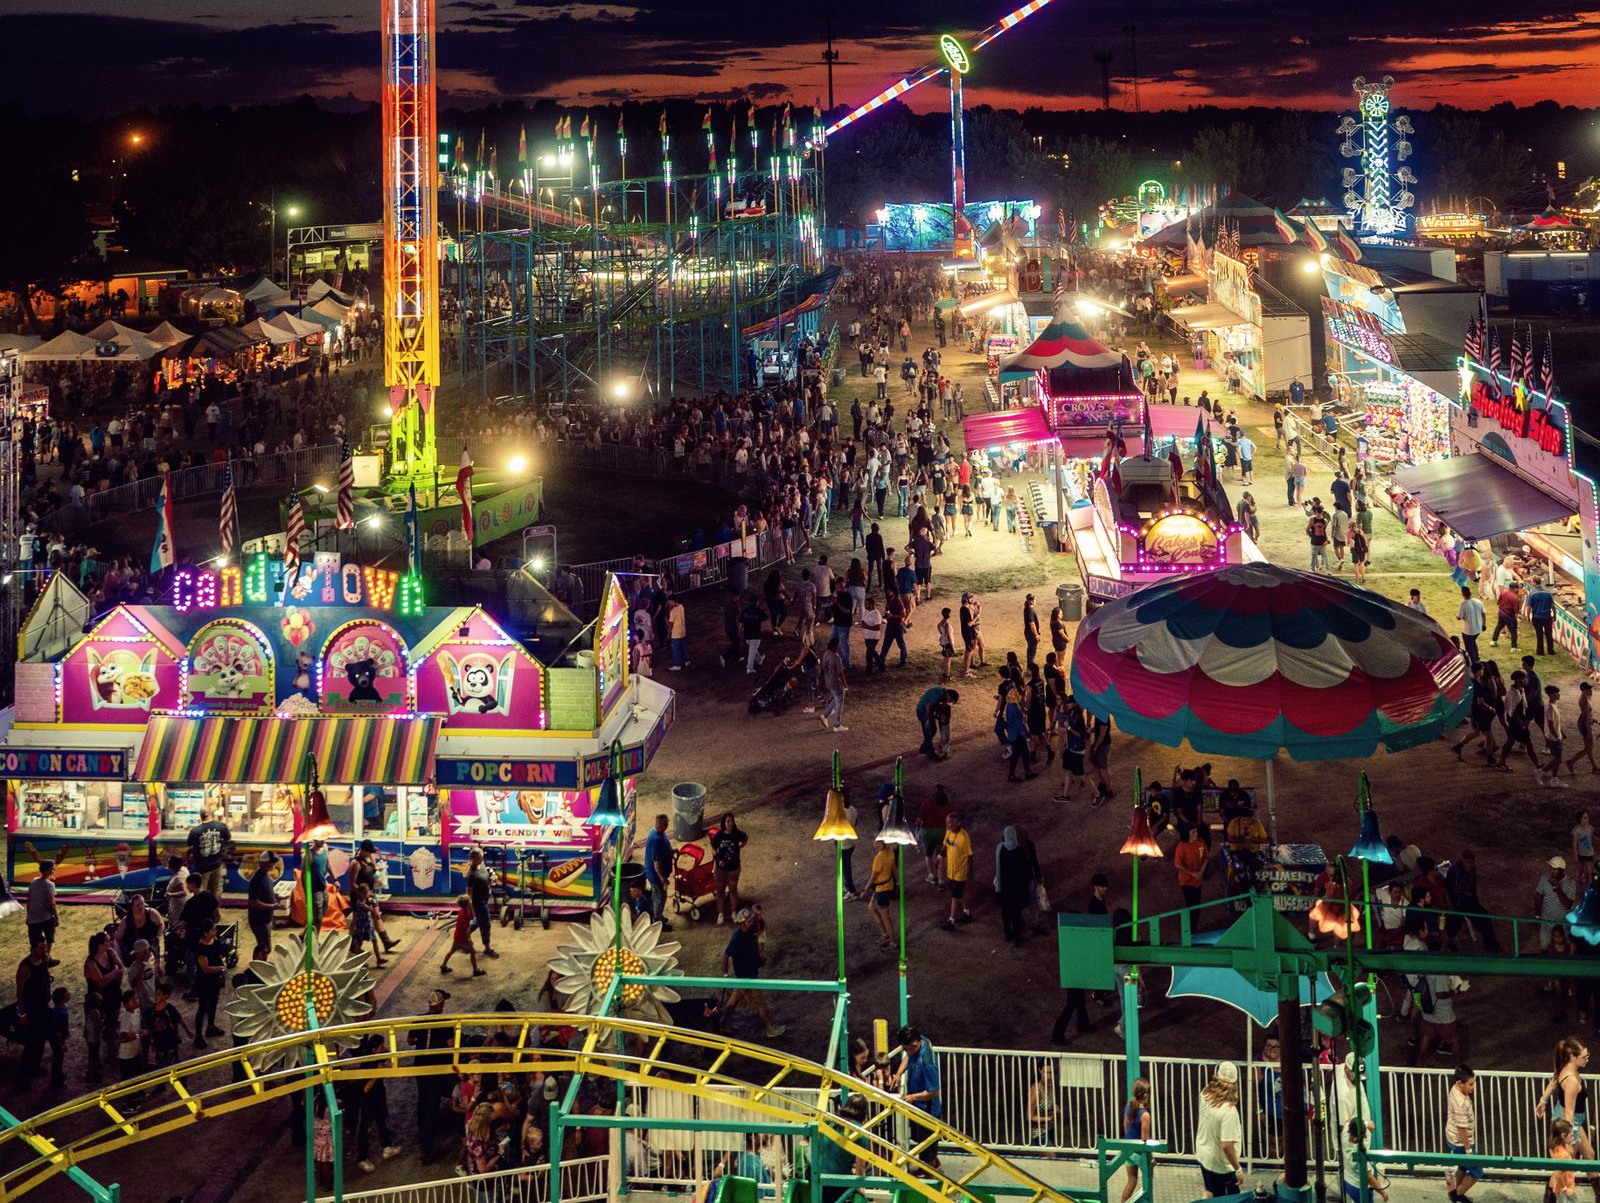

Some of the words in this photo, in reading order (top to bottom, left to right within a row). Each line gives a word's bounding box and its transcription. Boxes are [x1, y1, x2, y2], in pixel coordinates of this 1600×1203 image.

[66, 753, 121, 773] CANDY
[456, 762, 555, 783] POPCORN
[504, 828, 538, 837] CANDY
[1271, 881, 1288, 892] OF
